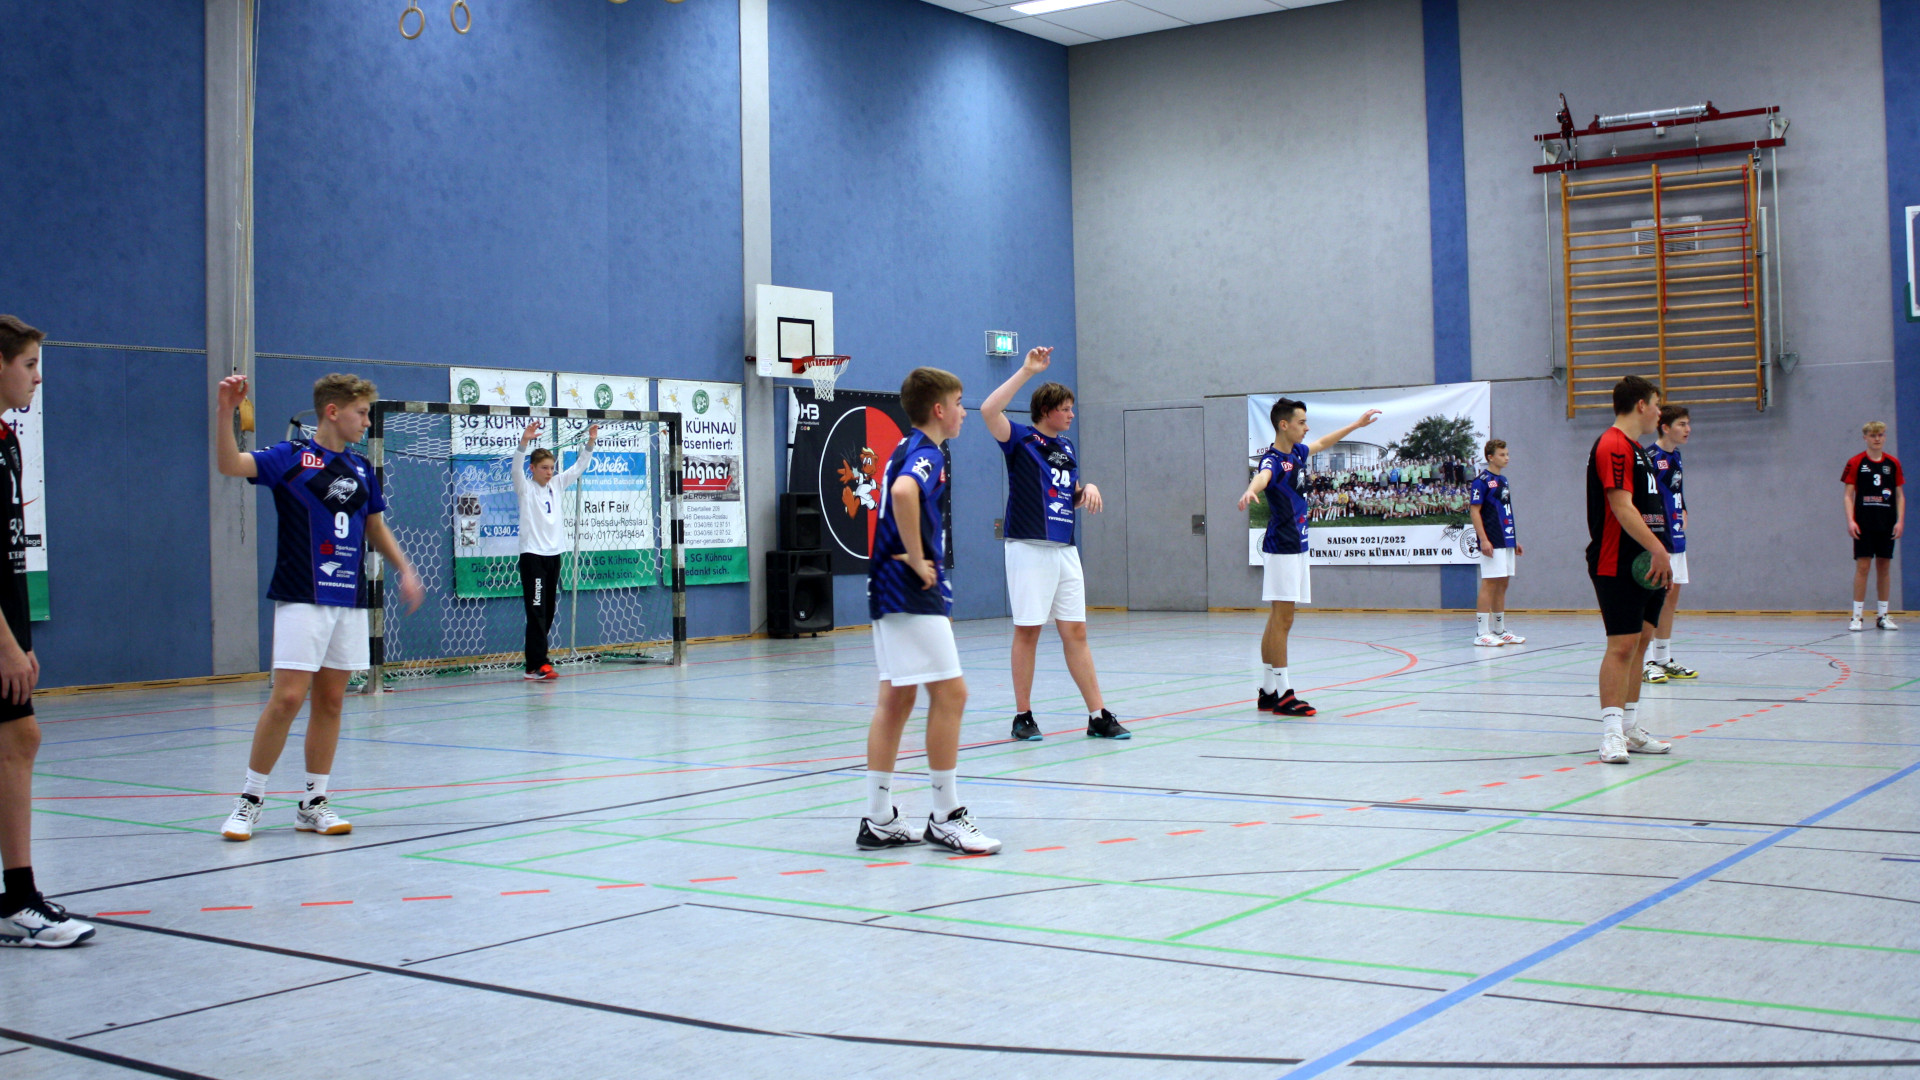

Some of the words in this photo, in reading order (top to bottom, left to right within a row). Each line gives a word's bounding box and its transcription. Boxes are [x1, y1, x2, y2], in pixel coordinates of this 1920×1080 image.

[800, 403, 820, 420] HB
[460, 414, 479, 428] SG
[685, 417, 736, 435] KÜHNAU
[464, 432, 542, 450] präsentirt:
[681, 436, 733, 450] äsentiert:
[586, 456, 629, 474] Debeka
[682, 459, 730, 485] ingner
[1050, 468, 1071, 488] 24
[1872, 473, 1881, 486] 3
[544, 501, 552, 514] 1
[584, 501, 606, 514] Ralf
[608, 501, 630, 513] Feix
[334, 511, 350, 539] 9
[493, 526, 511, 536] 0340
[1327, 536, 1358, 545] SAISON
[1360, 536, 1406, 545] 2021/2022
[690, 553, 703, 563] SG
[704, 552, 733, 562] Kühnau
[1309, 548, 1342, 558] ÜHNAU/
[1344, 549, 1366, 558] JSPG
[1368, 547, 1411, 557] KÜHNAU/
[1412, 548, 1439, 557] DRHV
[1441, 548, 1453, 556] 06
[685, 566, 711, 577] edankt
[712, 563, 730, 575] sich.
[533, 577, 543, 606] Kempa
